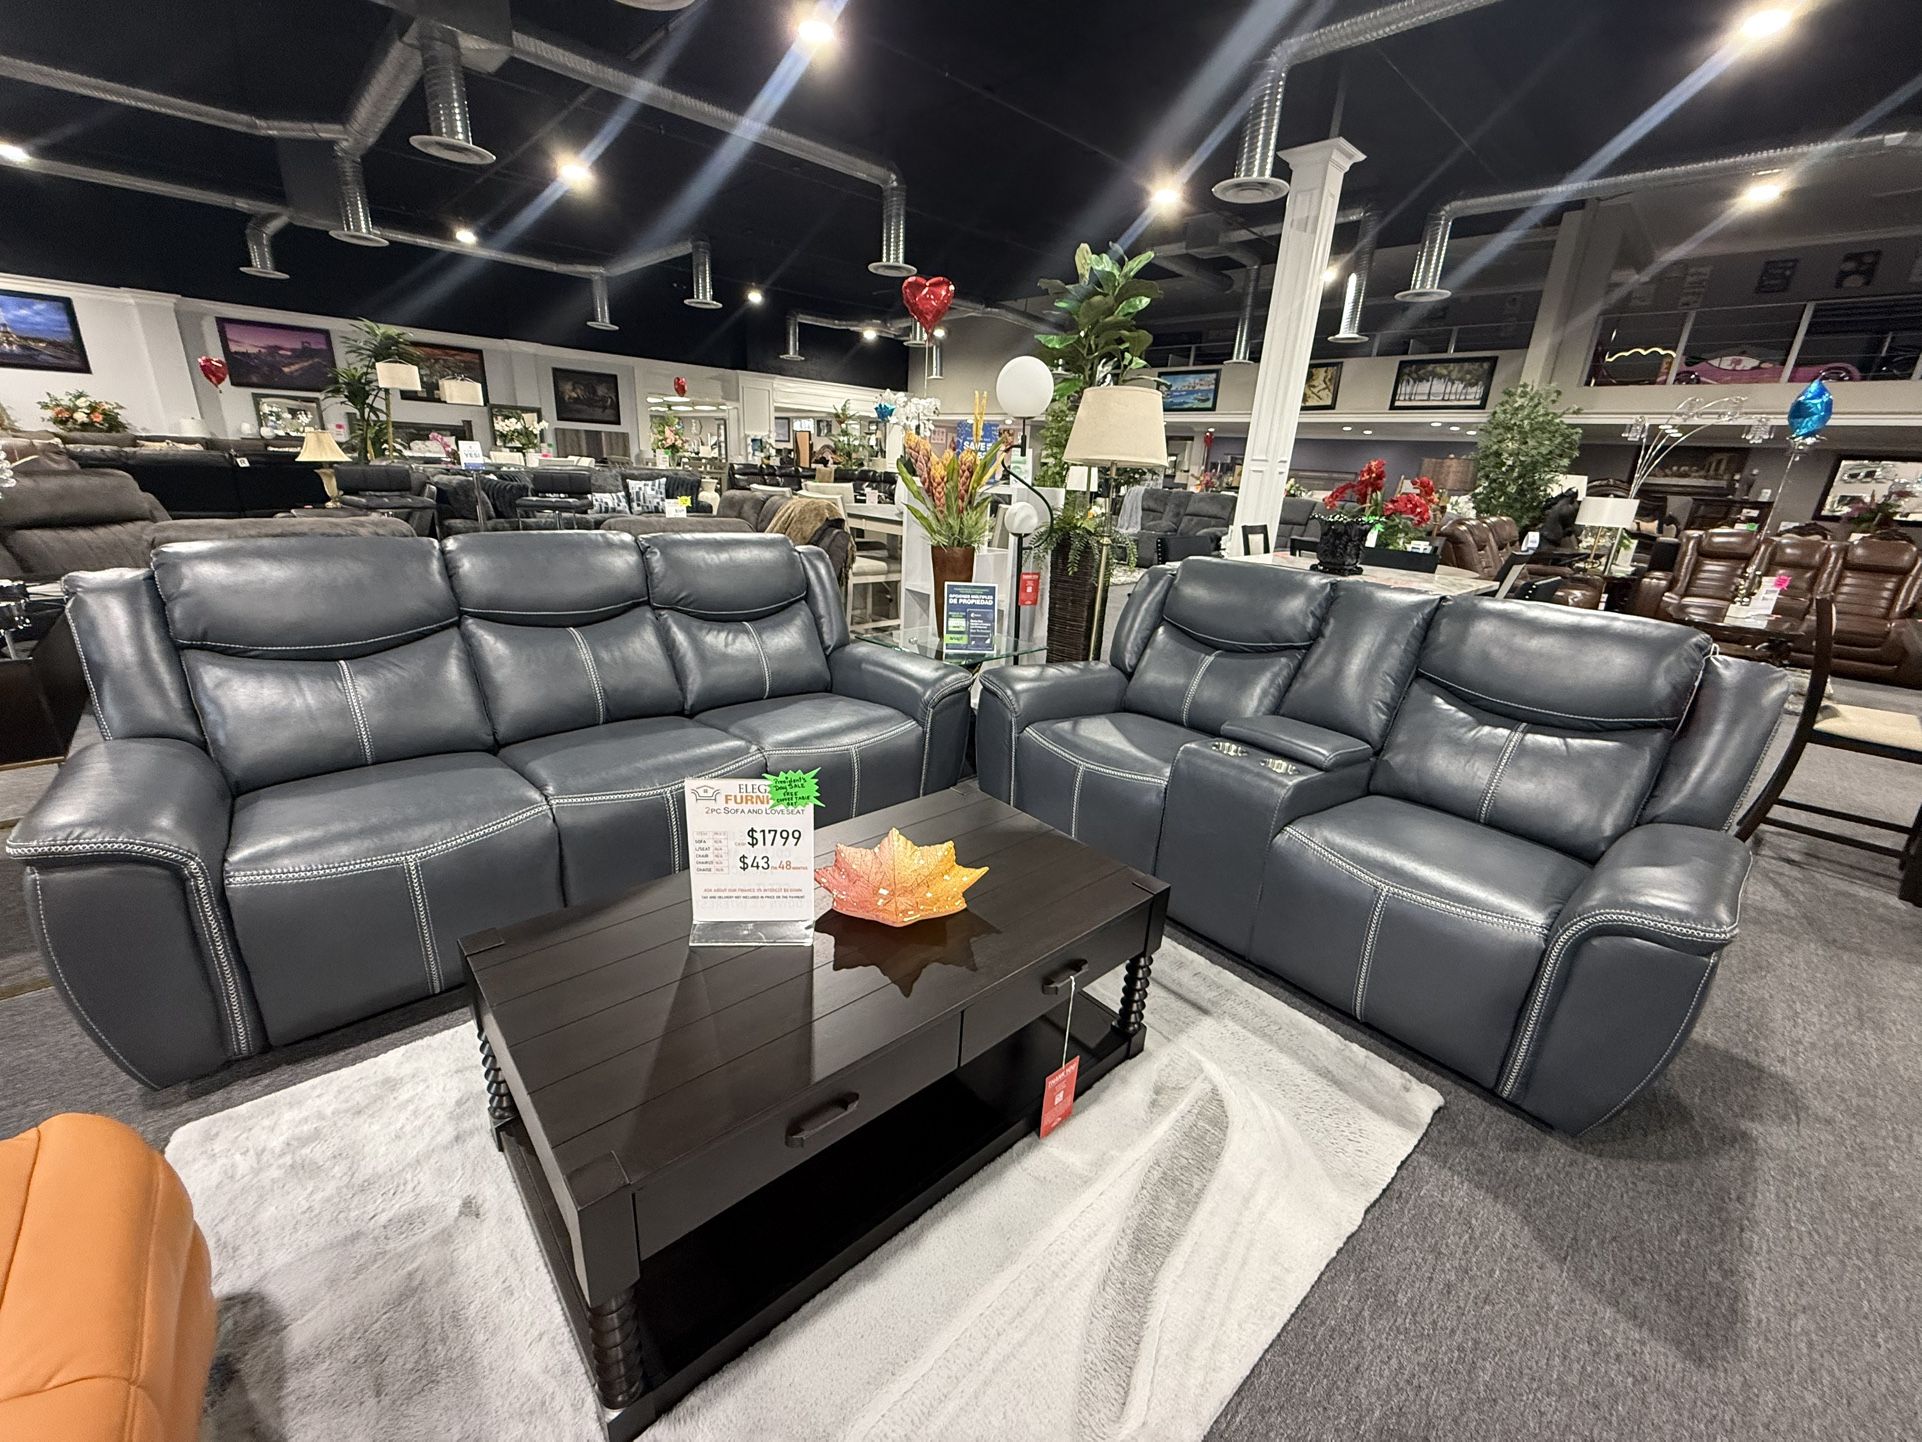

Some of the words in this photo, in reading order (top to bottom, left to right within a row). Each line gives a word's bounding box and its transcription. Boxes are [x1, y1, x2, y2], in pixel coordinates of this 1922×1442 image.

[739, 784, 770, 794] ELEG
[747, 827, 802, 848] $1799
[739, 854, 770, 871] $43
[778, 860, 792, 870] 48
